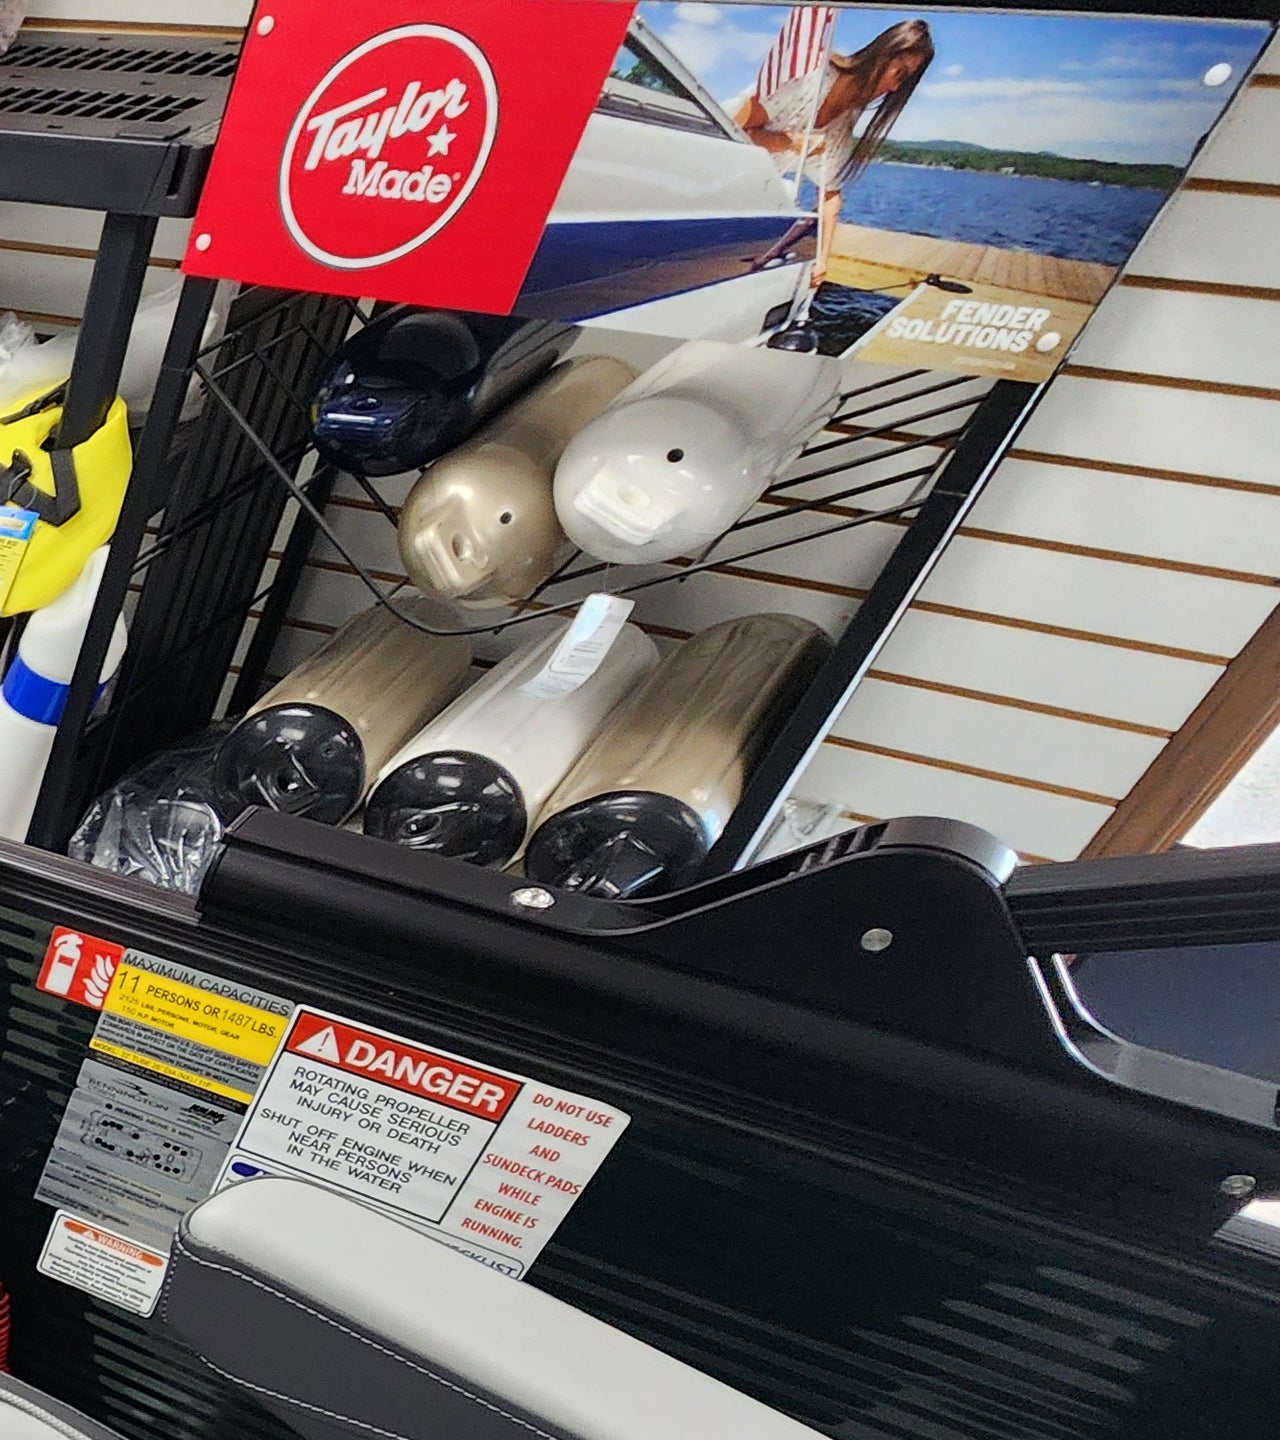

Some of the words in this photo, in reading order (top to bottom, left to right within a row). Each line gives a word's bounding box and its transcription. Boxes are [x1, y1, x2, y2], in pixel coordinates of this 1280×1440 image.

[304, 78, 469, 171] Taylor
[342, 159, 453, 203] Made
[887, 316, 1034, 352] SOLUTIONS
[940, 299, 1051, 332] FENDER
[118, 970, 141, 993] 11
[145, 984, 201, 1011] PERSONS
[201, 1003, 221, 1018] OR
[221, 1009, 252, 1029] 1487
[250, 1020, 280, 1038] LBS.
[123, 953, 196, 985] MAXIMUM
[197, 977, 291, 1016] CAPACITIES
[345, 1039, 505, 1113] DANGER
[289, 1078, 325, 1098] MAY
[327, 1091, 381, 1119] CAUSE
[387, 1113, 462, 1148] SERIOUS
[294, 1066, 370, 1100] ROTATING
[374, 1094, 471, 1135] PROPELLER
[532, 1093, 555, 1109] DO
[554, 1100, 586, 1118] NOT
[585, 1110, 614, 1129] USE
[297, 1095, 353, 1123] INJURY
[358, 1117, 381, 1134] OR
[386, 1128, 441, 1155] DEATH
[527, 1117, 591, 1147] LADDERS
[260, 1108, 302, 1129] SHUT
[307, 1124, 339, 1142] OFF
[342, 1136, 403, 1166] ENGINE
[408, 1159, 458, 1187] WHEN
[287, 1144, 301, 1156] IN
[309, 1151, 341, 1172] THE
[347, 1165, 403, 1195] WATER
[288, 1131, 331, 1153] NEAR
[335, 1147, 413, 1184] PERSONS
[528, 1144, 561, 1163] AND
[482, 1153, 546, 1184] SUNDECK
[545, 1174, 582, 1196] PADS
[497, 1181, 542, 1207] WHILE
[461, 1217, 523, 1250] RUNNING.
[474, 1198, 525, 1225] ENGINE
[523, 1216, 539, 1230] IS
[96, 1233, 144, 1260] WARNING
